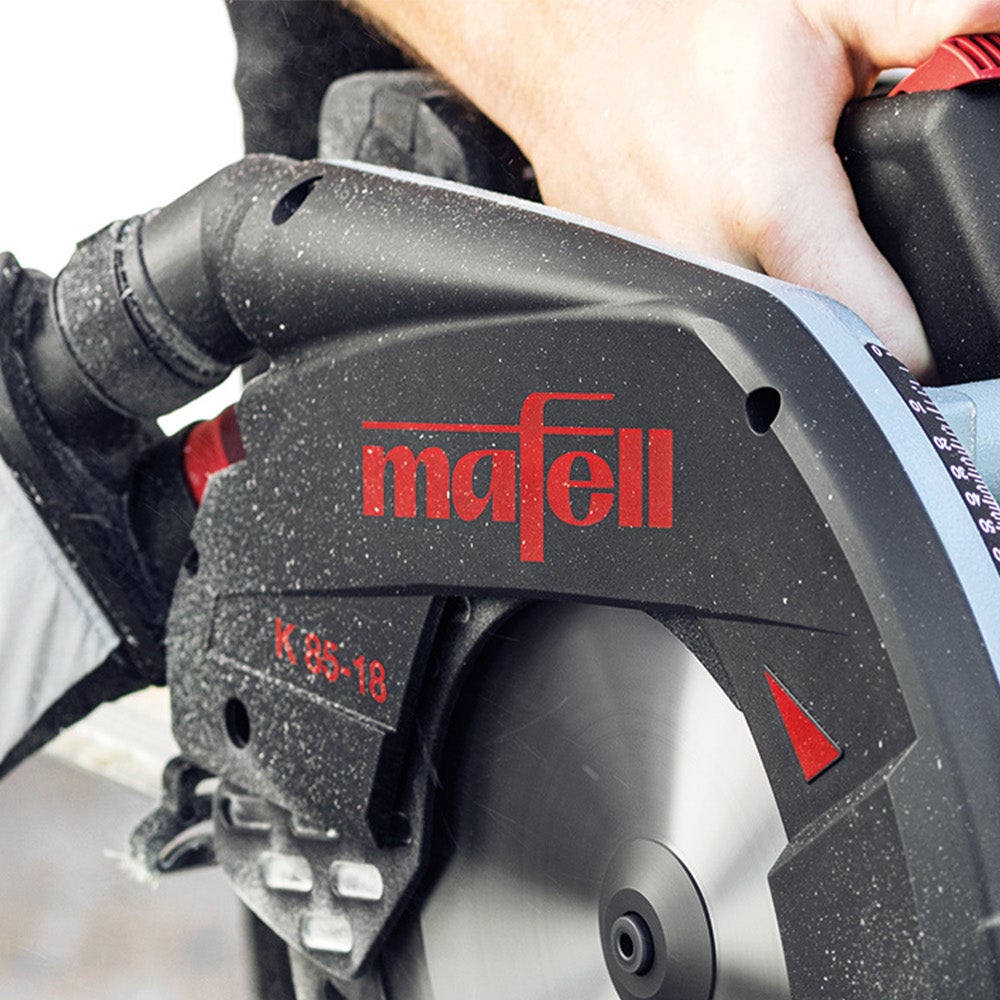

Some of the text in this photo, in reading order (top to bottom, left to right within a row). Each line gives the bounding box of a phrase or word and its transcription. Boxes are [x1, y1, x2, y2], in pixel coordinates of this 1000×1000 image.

[908, 399, 927, 413] 10
[933, 435, 952, 451] 20
[361, 392, 674, 562] mafell
[950, 465, 969, 480] 30
[965, 491, 981, 507] 40
[978, 518, 996, 534] 50
[275, 617, 388, 704] K 85-18
